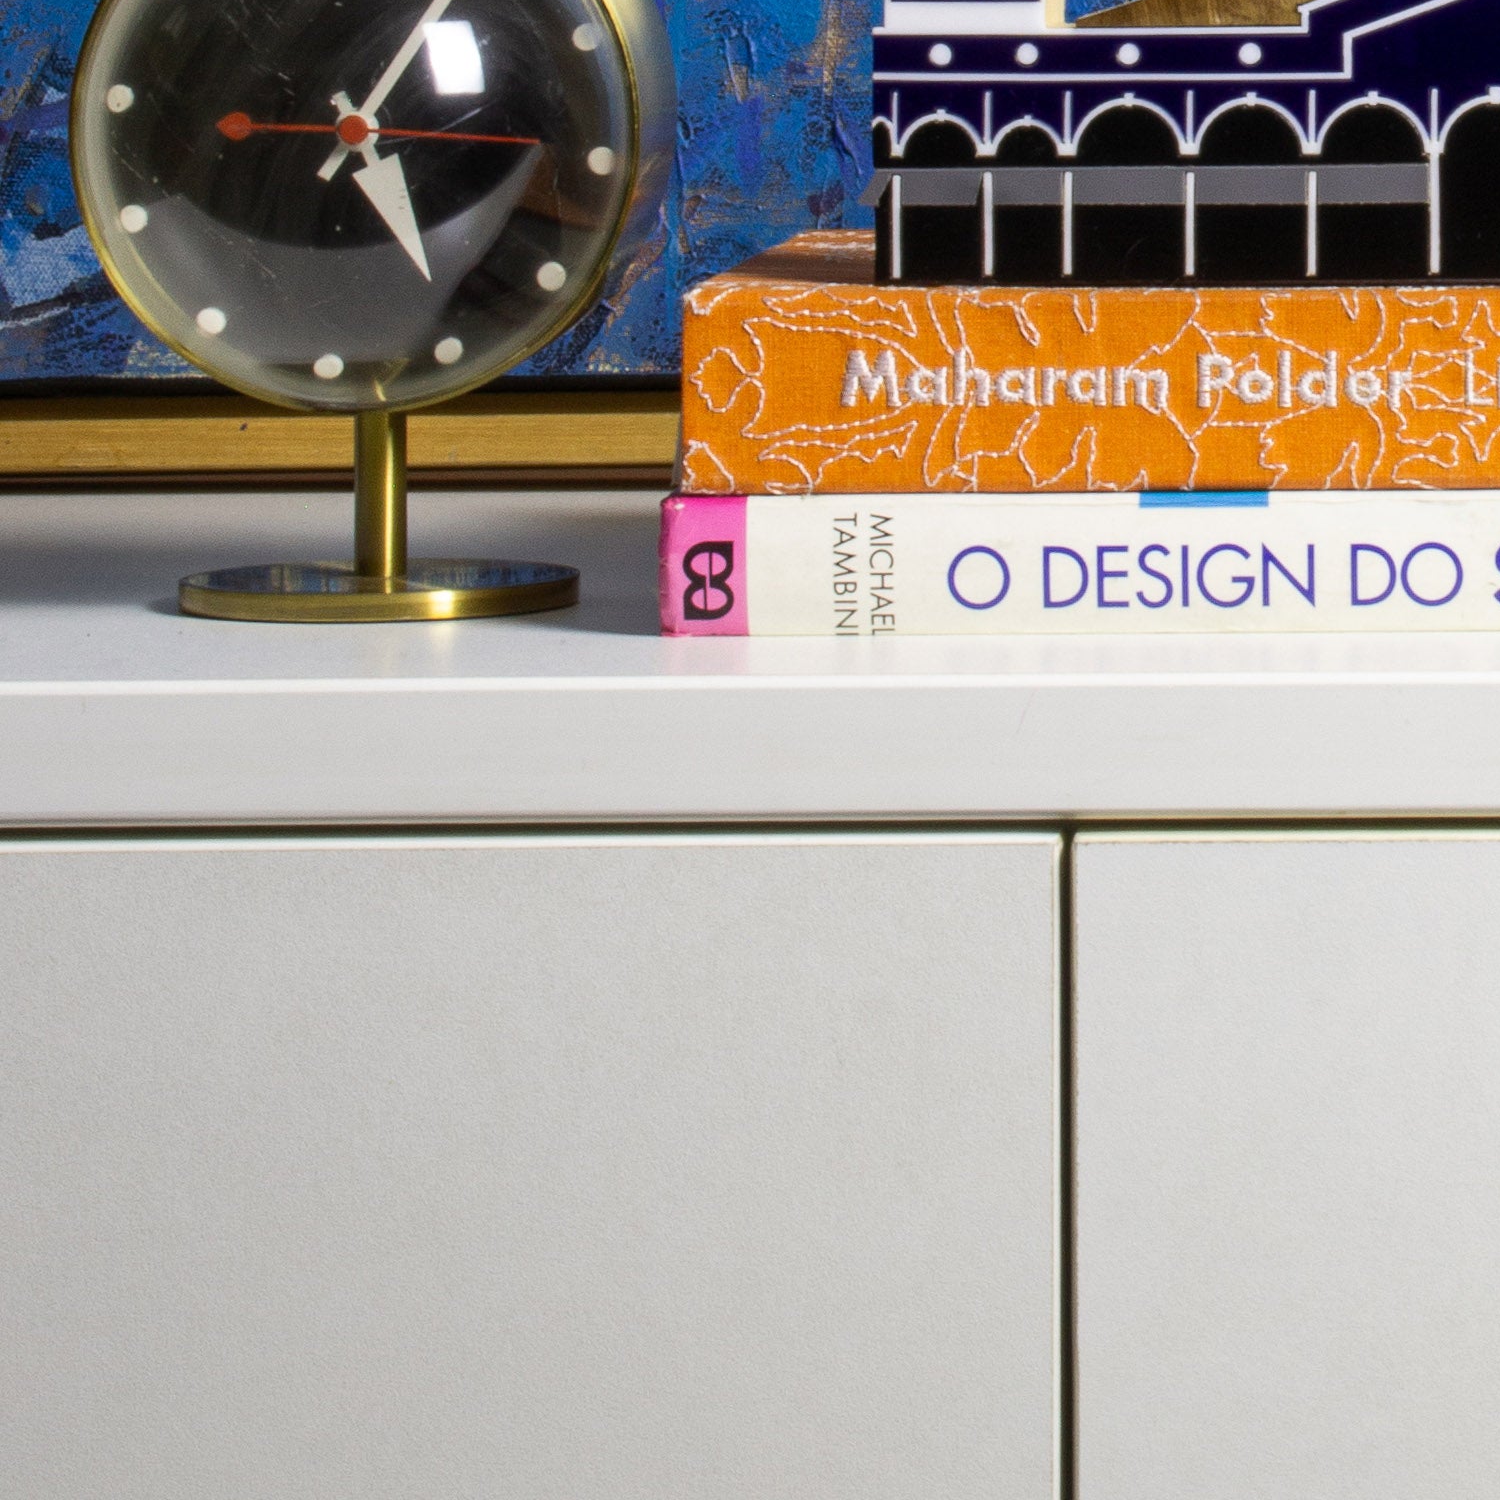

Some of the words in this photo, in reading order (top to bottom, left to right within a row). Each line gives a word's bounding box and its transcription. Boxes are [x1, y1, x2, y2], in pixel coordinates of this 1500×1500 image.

[840, 349, 1170, 407] Maharam
[1196, 349, 1412, 408] Polder
[833, 513, 859, 636] TAMBINI
[869, 514, 896, 636] MICHAEL
[947, 545, 1011, 610] O
[1043, 543, 1316, 608] DESIGN
[1350, 542, 1464, 607] DO
